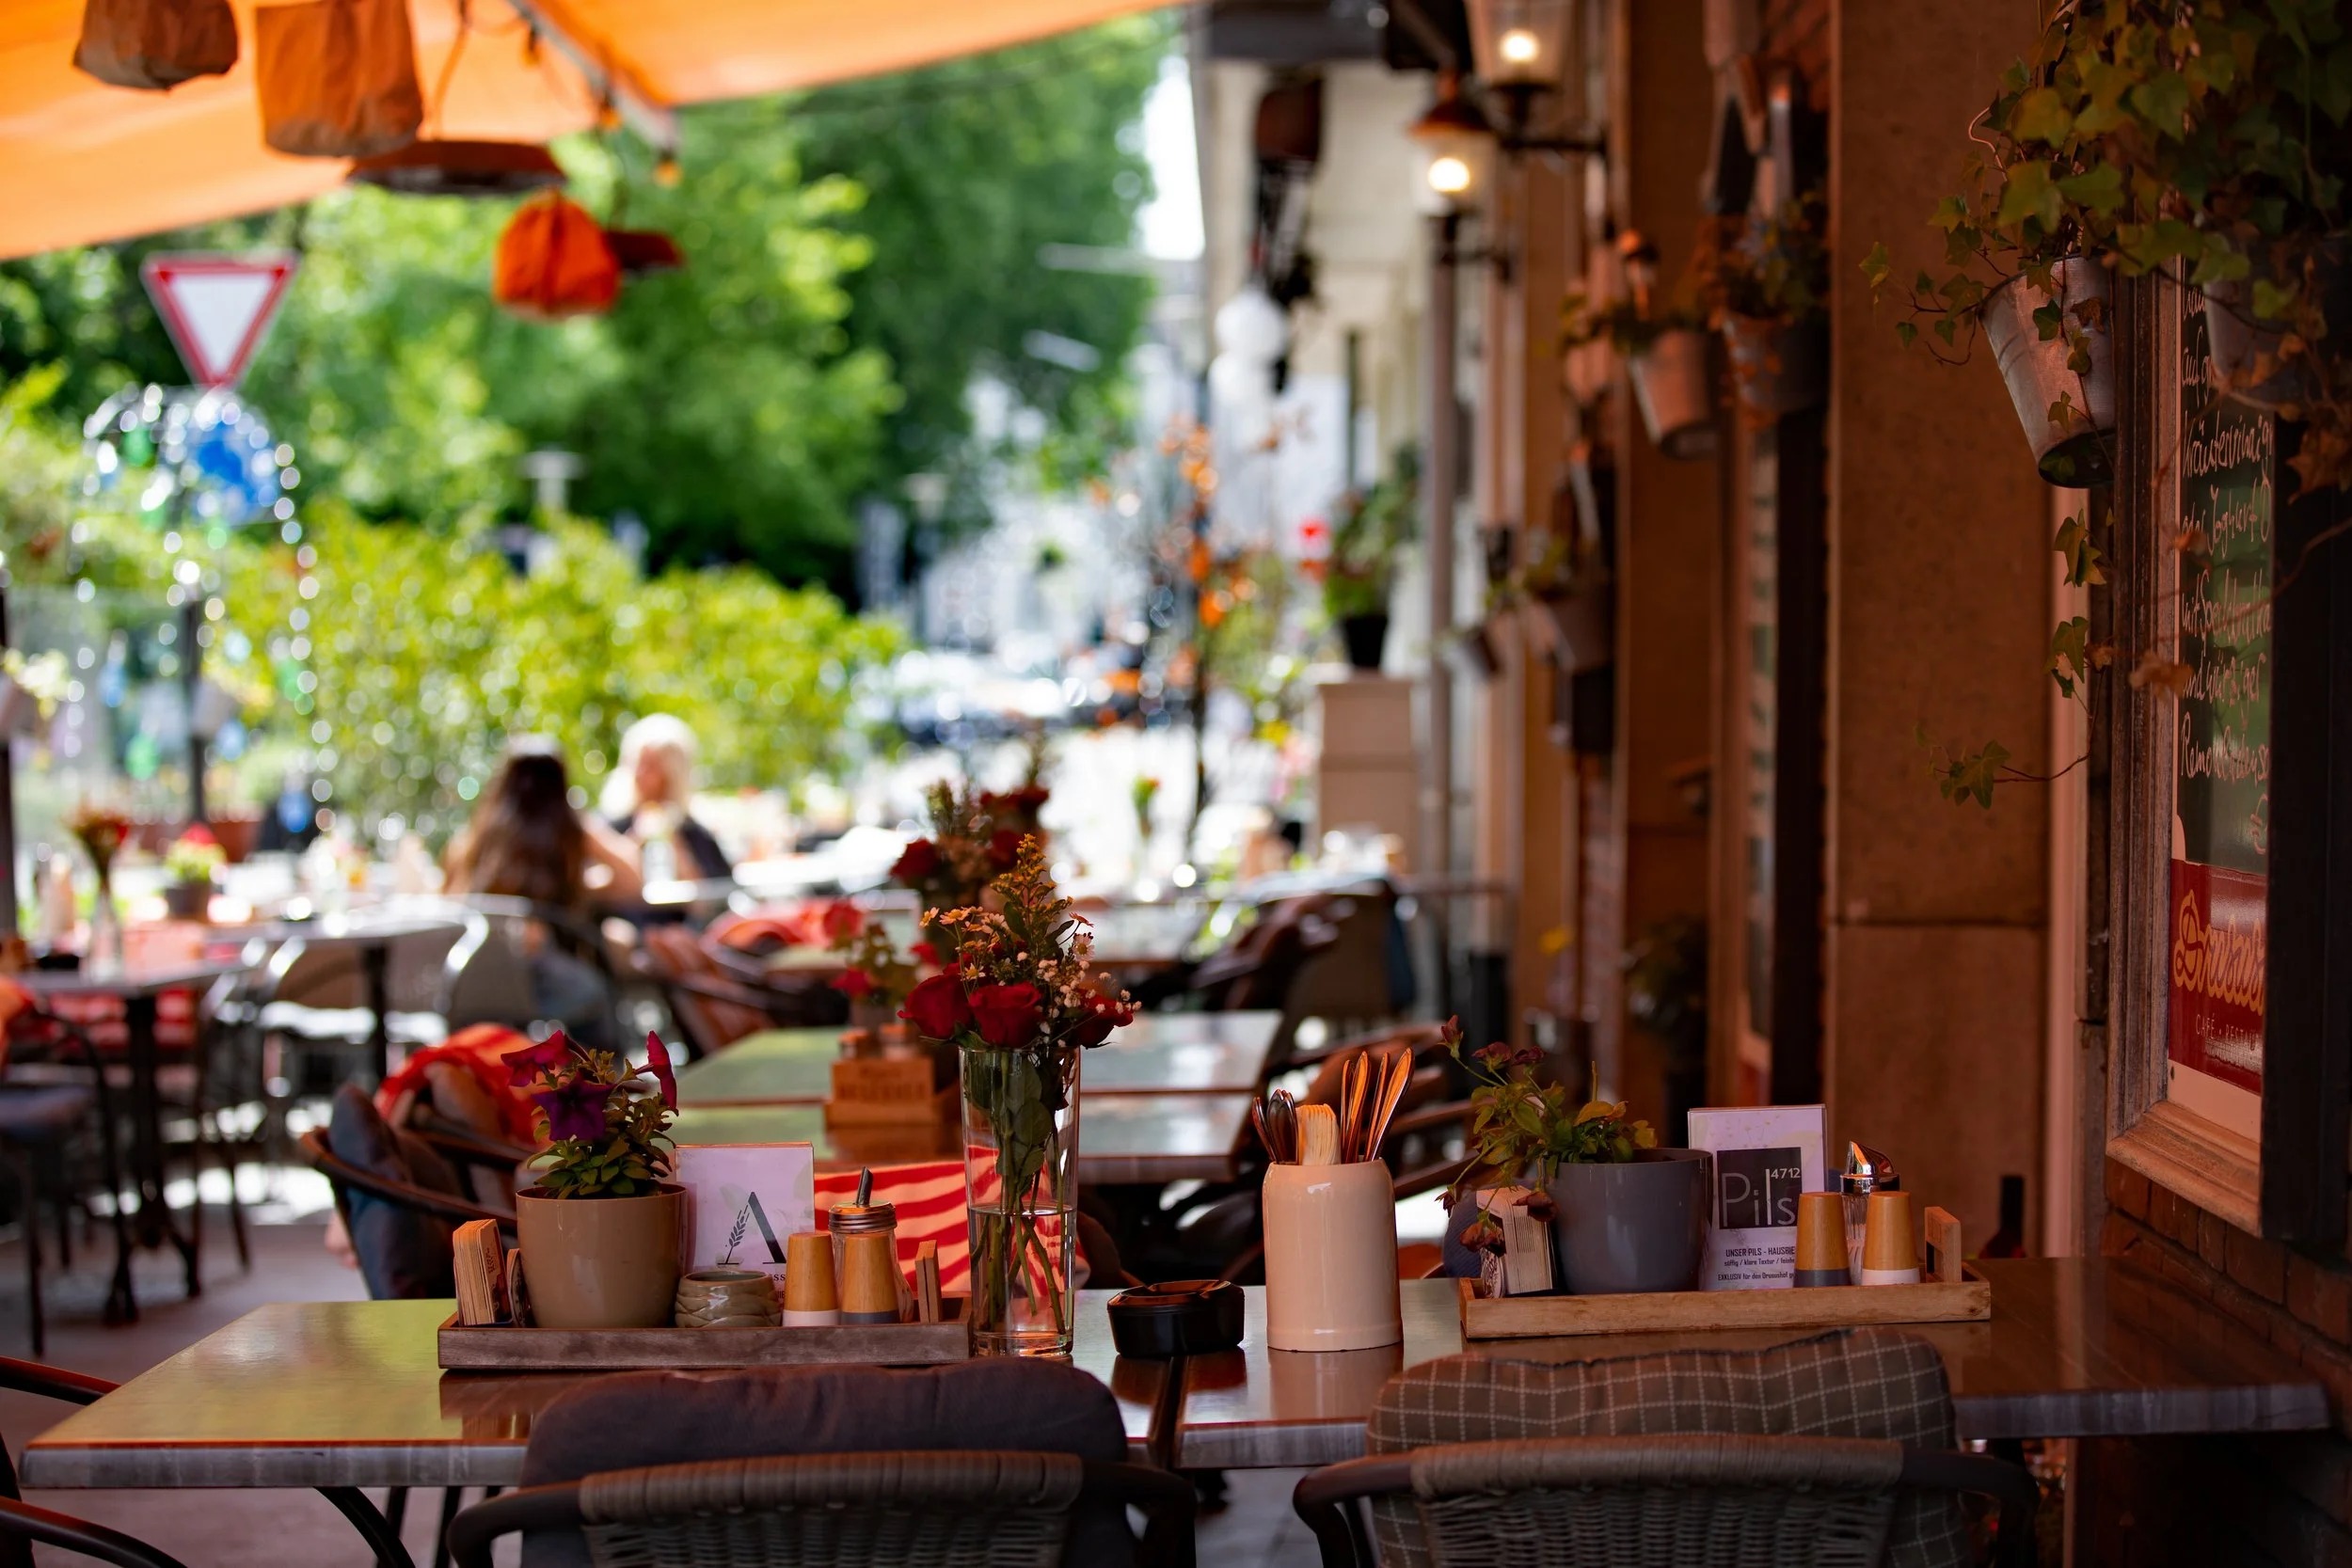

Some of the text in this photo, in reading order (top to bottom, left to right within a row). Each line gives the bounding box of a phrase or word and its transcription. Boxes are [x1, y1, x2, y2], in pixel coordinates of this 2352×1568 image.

[2207, 477, 2258, 560] Joghurt
[2195, 1013, 2215, 1040] CAFÉ
[1771, 1167, 1801, 1179] 4712
[1722, 1168, 1796, 1227] Pils
[1725, 1248, 1748, 1258] UNSER
[1748, 1247, 1762, 1257] PILS
[1718, 1273, 1741, 1281] EXKLUSIV
